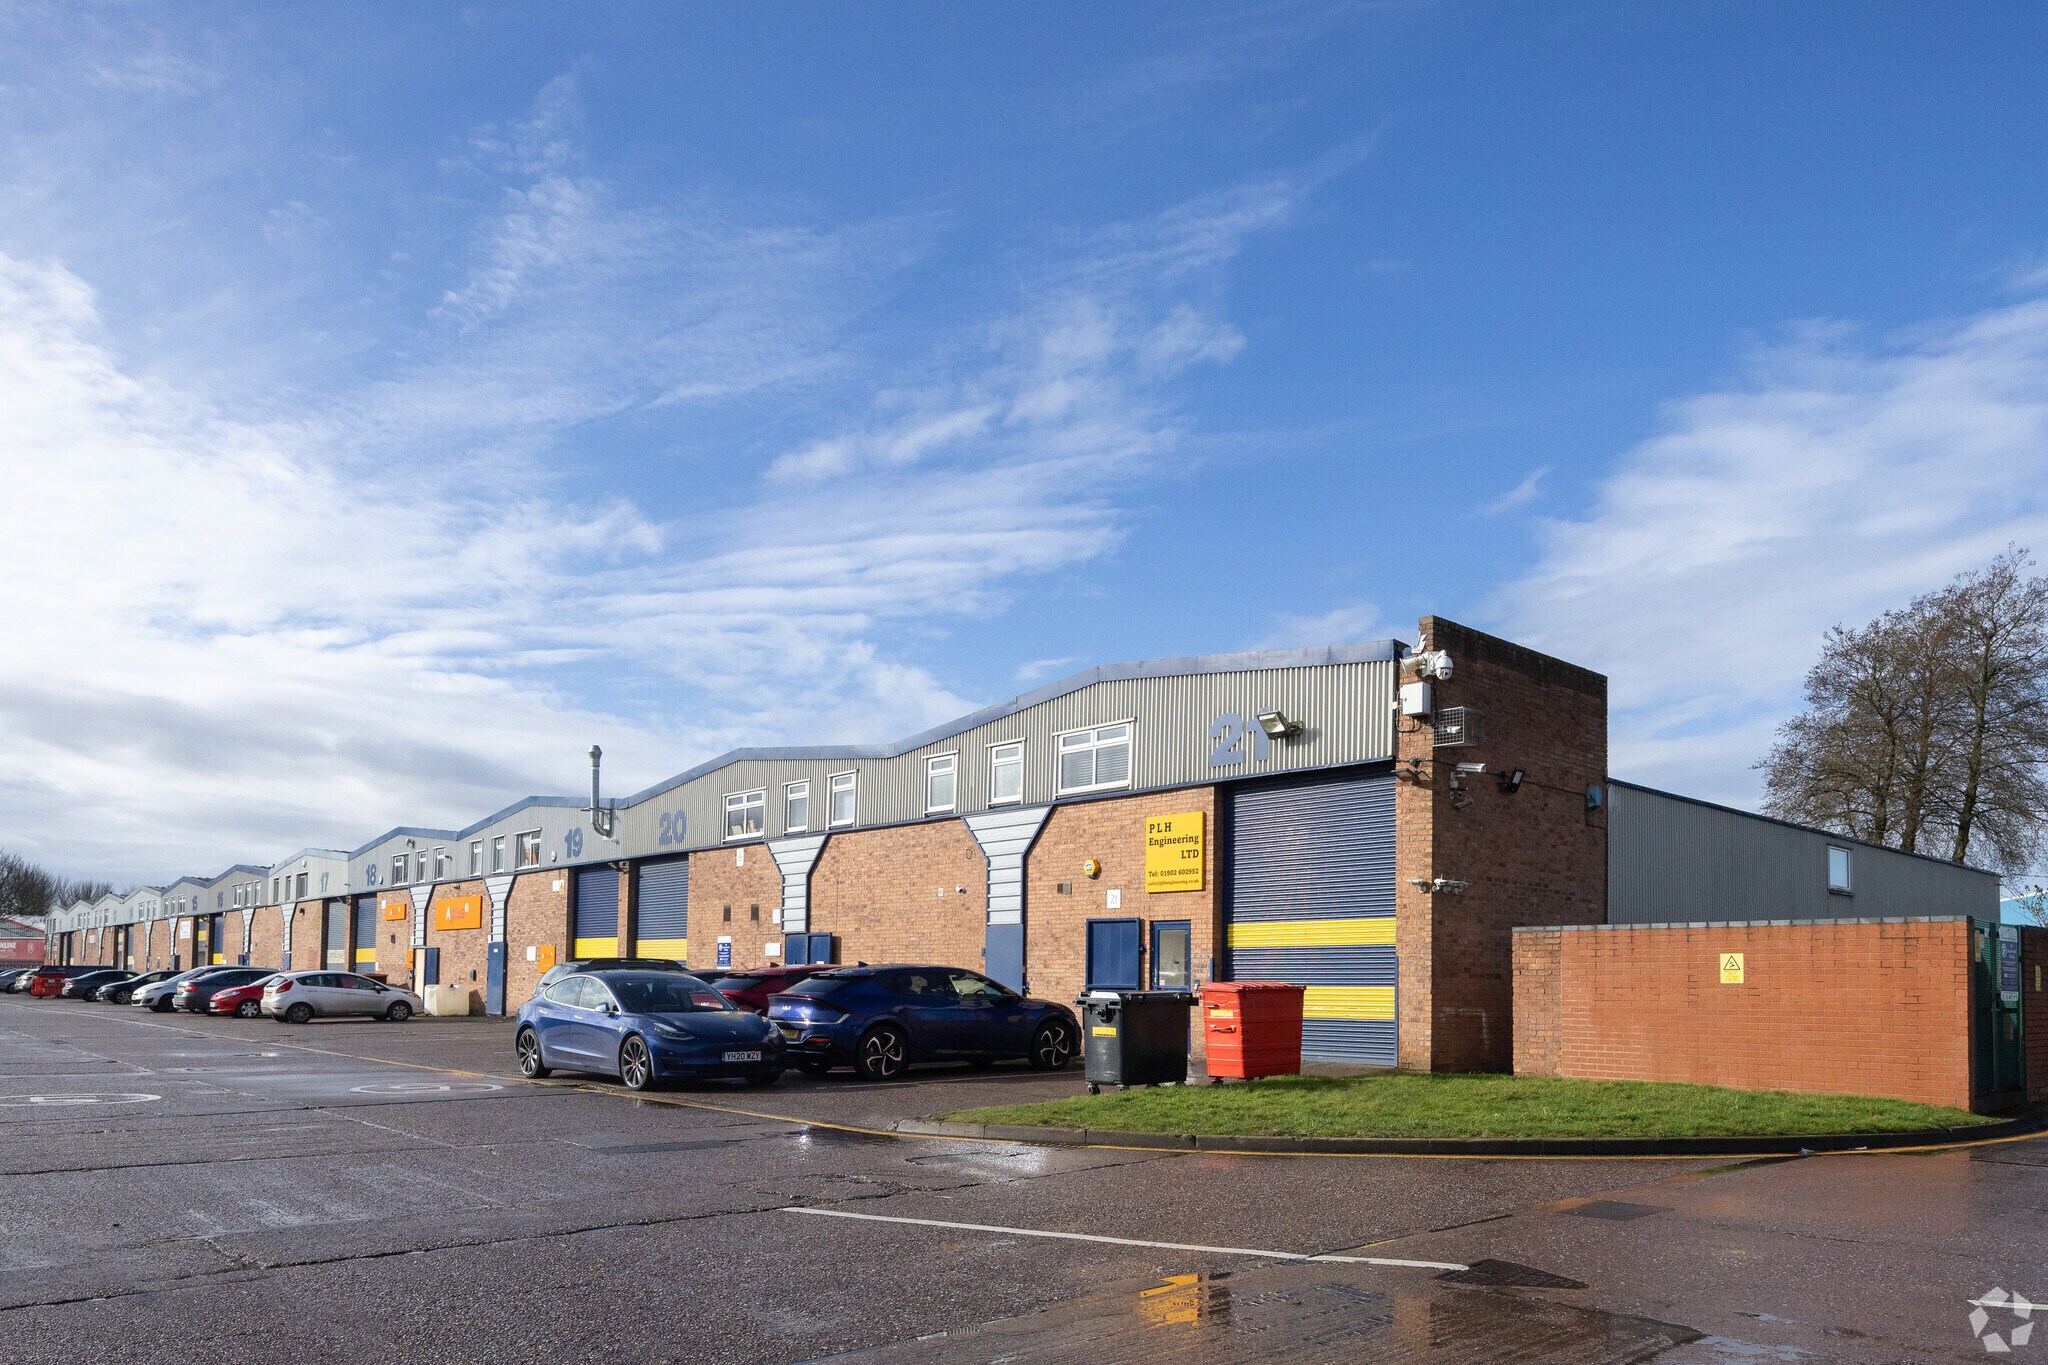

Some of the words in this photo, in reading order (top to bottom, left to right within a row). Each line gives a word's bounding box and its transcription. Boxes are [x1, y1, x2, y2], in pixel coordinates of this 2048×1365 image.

[1210, 707, 1269, 768] 21
[658, 809, 687, 846] 20
[564, 827, 583, 858] 19
[1149, 834, 1199, 848] Engineering
[1181, 849, 1199, 859] LTD
[365, 863, 377, 887] 18
[1148, 870, 1159, 878] Tel:
[1160, 869, 1177, 877] 01902
[726, 1052, 746, 1061] YH20
